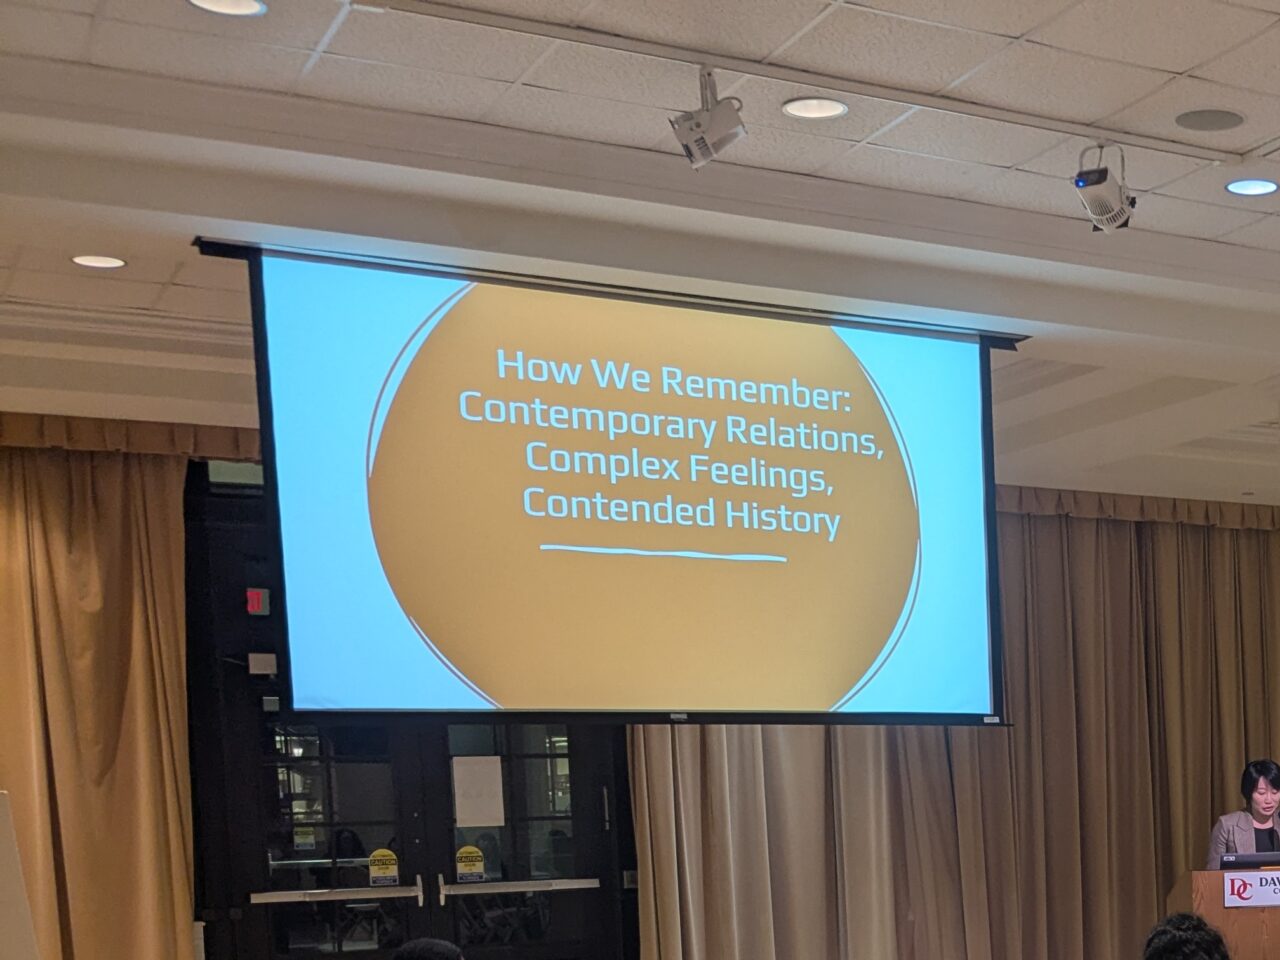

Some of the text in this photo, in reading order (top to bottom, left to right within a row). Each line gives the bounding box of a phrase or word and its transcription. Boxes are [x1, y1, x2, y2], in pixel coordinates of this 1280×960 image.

[497, 348, 853, 413] How We Remember:
[459, 390, 885, 461] Contemporary Relations,
[526, 441, 834, 499] Complex Feelings,
[523, 486, 841, 542] Contended History
